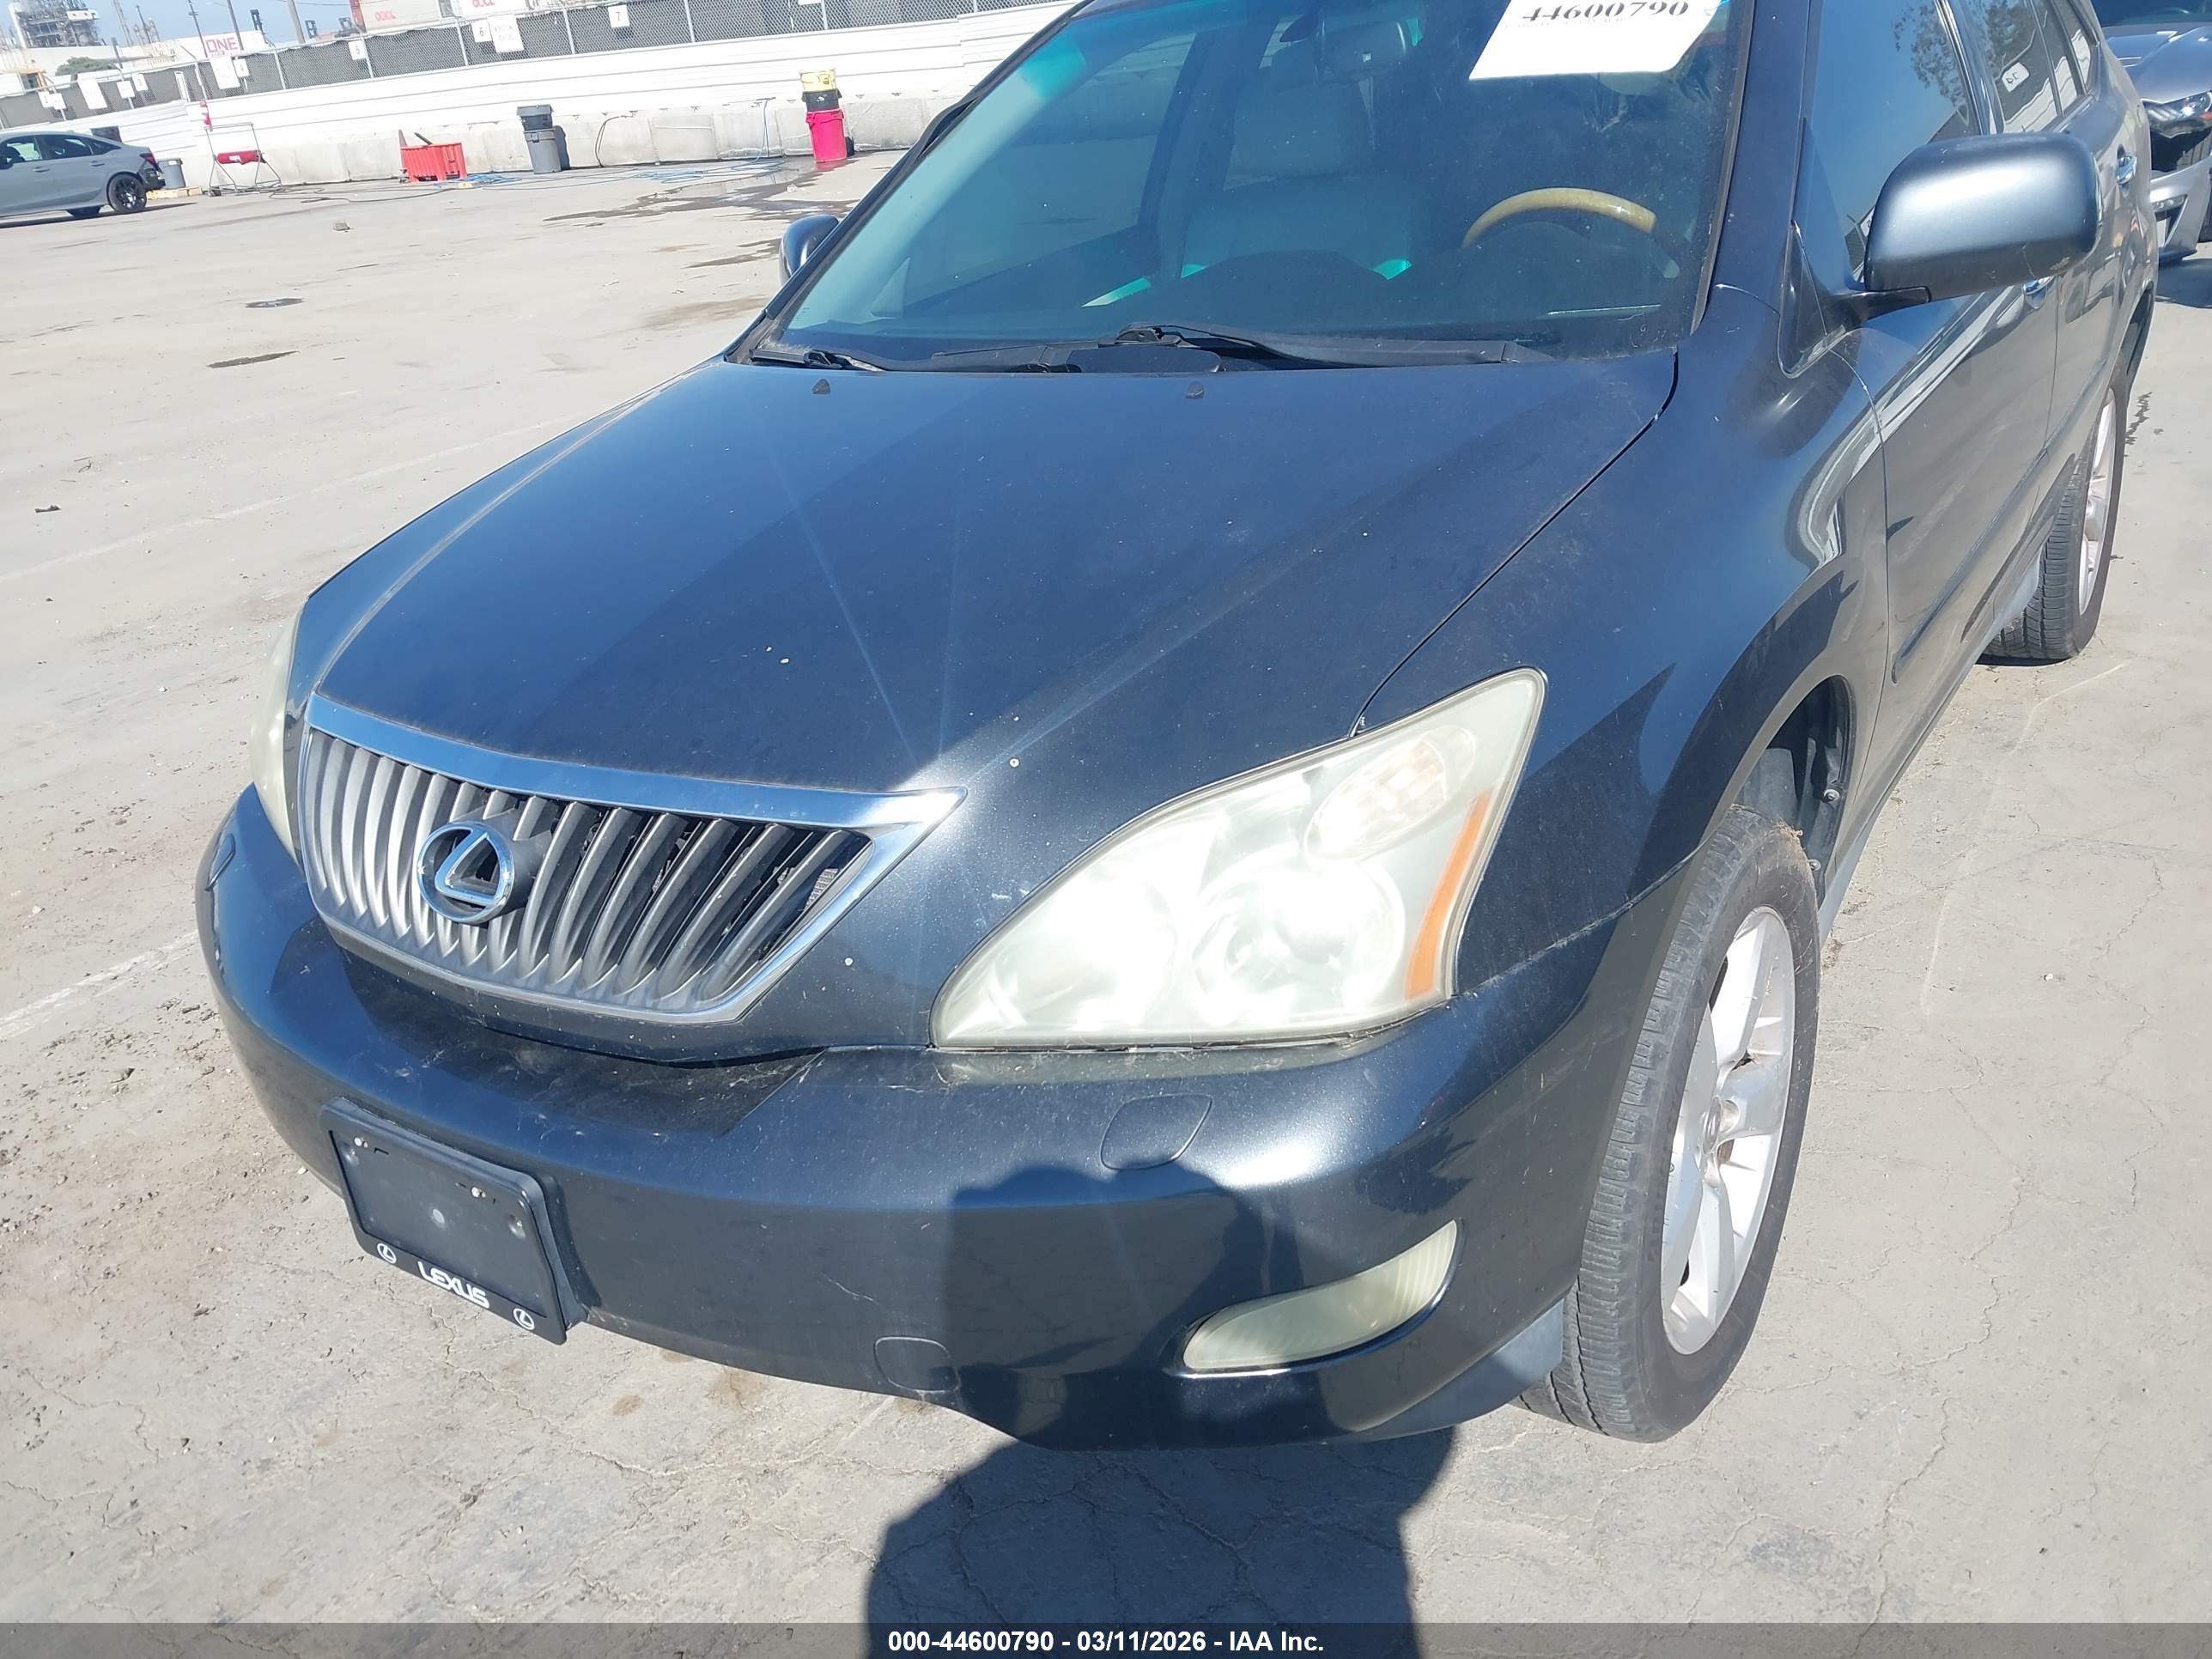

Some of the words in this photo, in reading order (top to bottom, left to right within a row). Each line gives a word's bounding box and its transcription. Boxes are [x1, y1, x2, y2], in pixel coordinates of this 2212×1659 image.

[1522, 1, 1689, 21] 44600790
[206, 37, 238, 53] ONE
[418, 1261, 489, 1309] LEXUS
